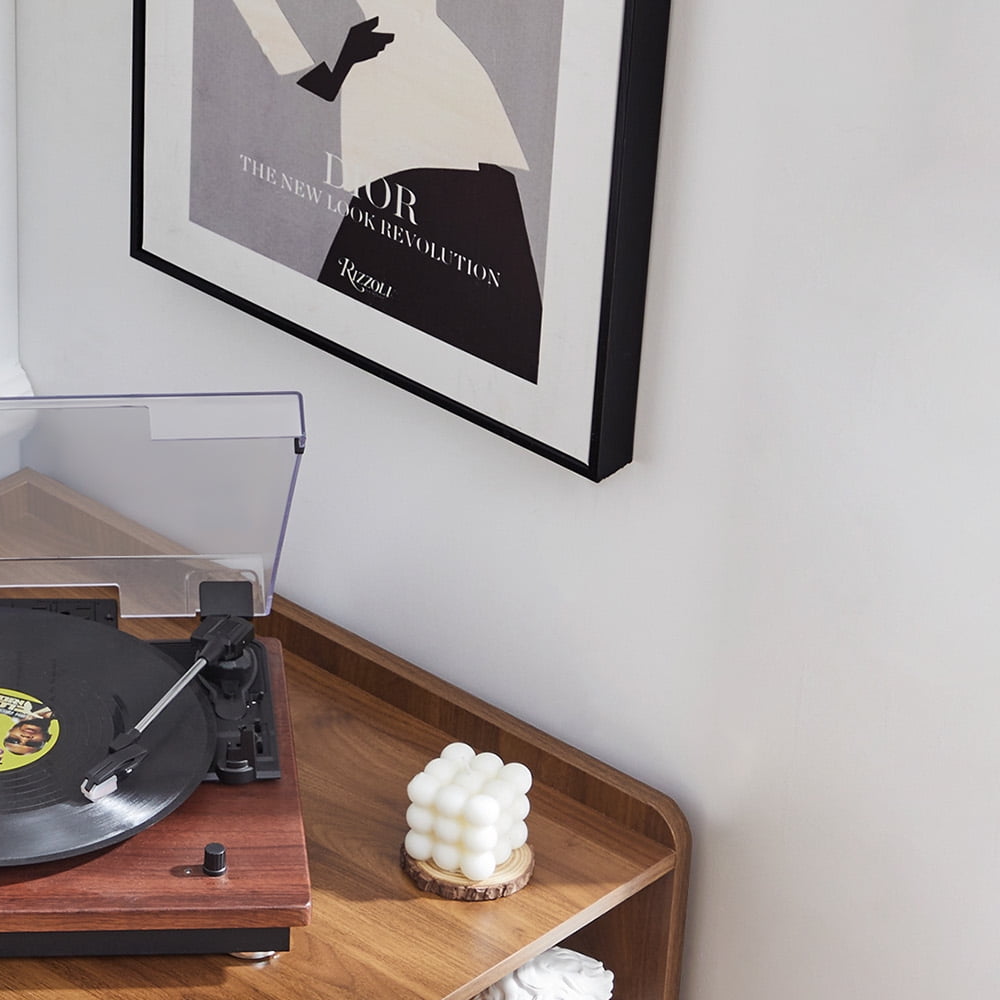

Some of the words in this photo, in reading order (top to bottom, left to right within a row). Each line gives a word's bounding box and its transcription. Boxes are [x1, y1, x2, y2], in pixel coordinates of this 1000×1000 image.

[239, 153, 277, 185] THE
[281, 172, 323, 205] NEW
[327, 194, 376, 231] LOOK
[380, 218, 501, 288] REVOLUTION
